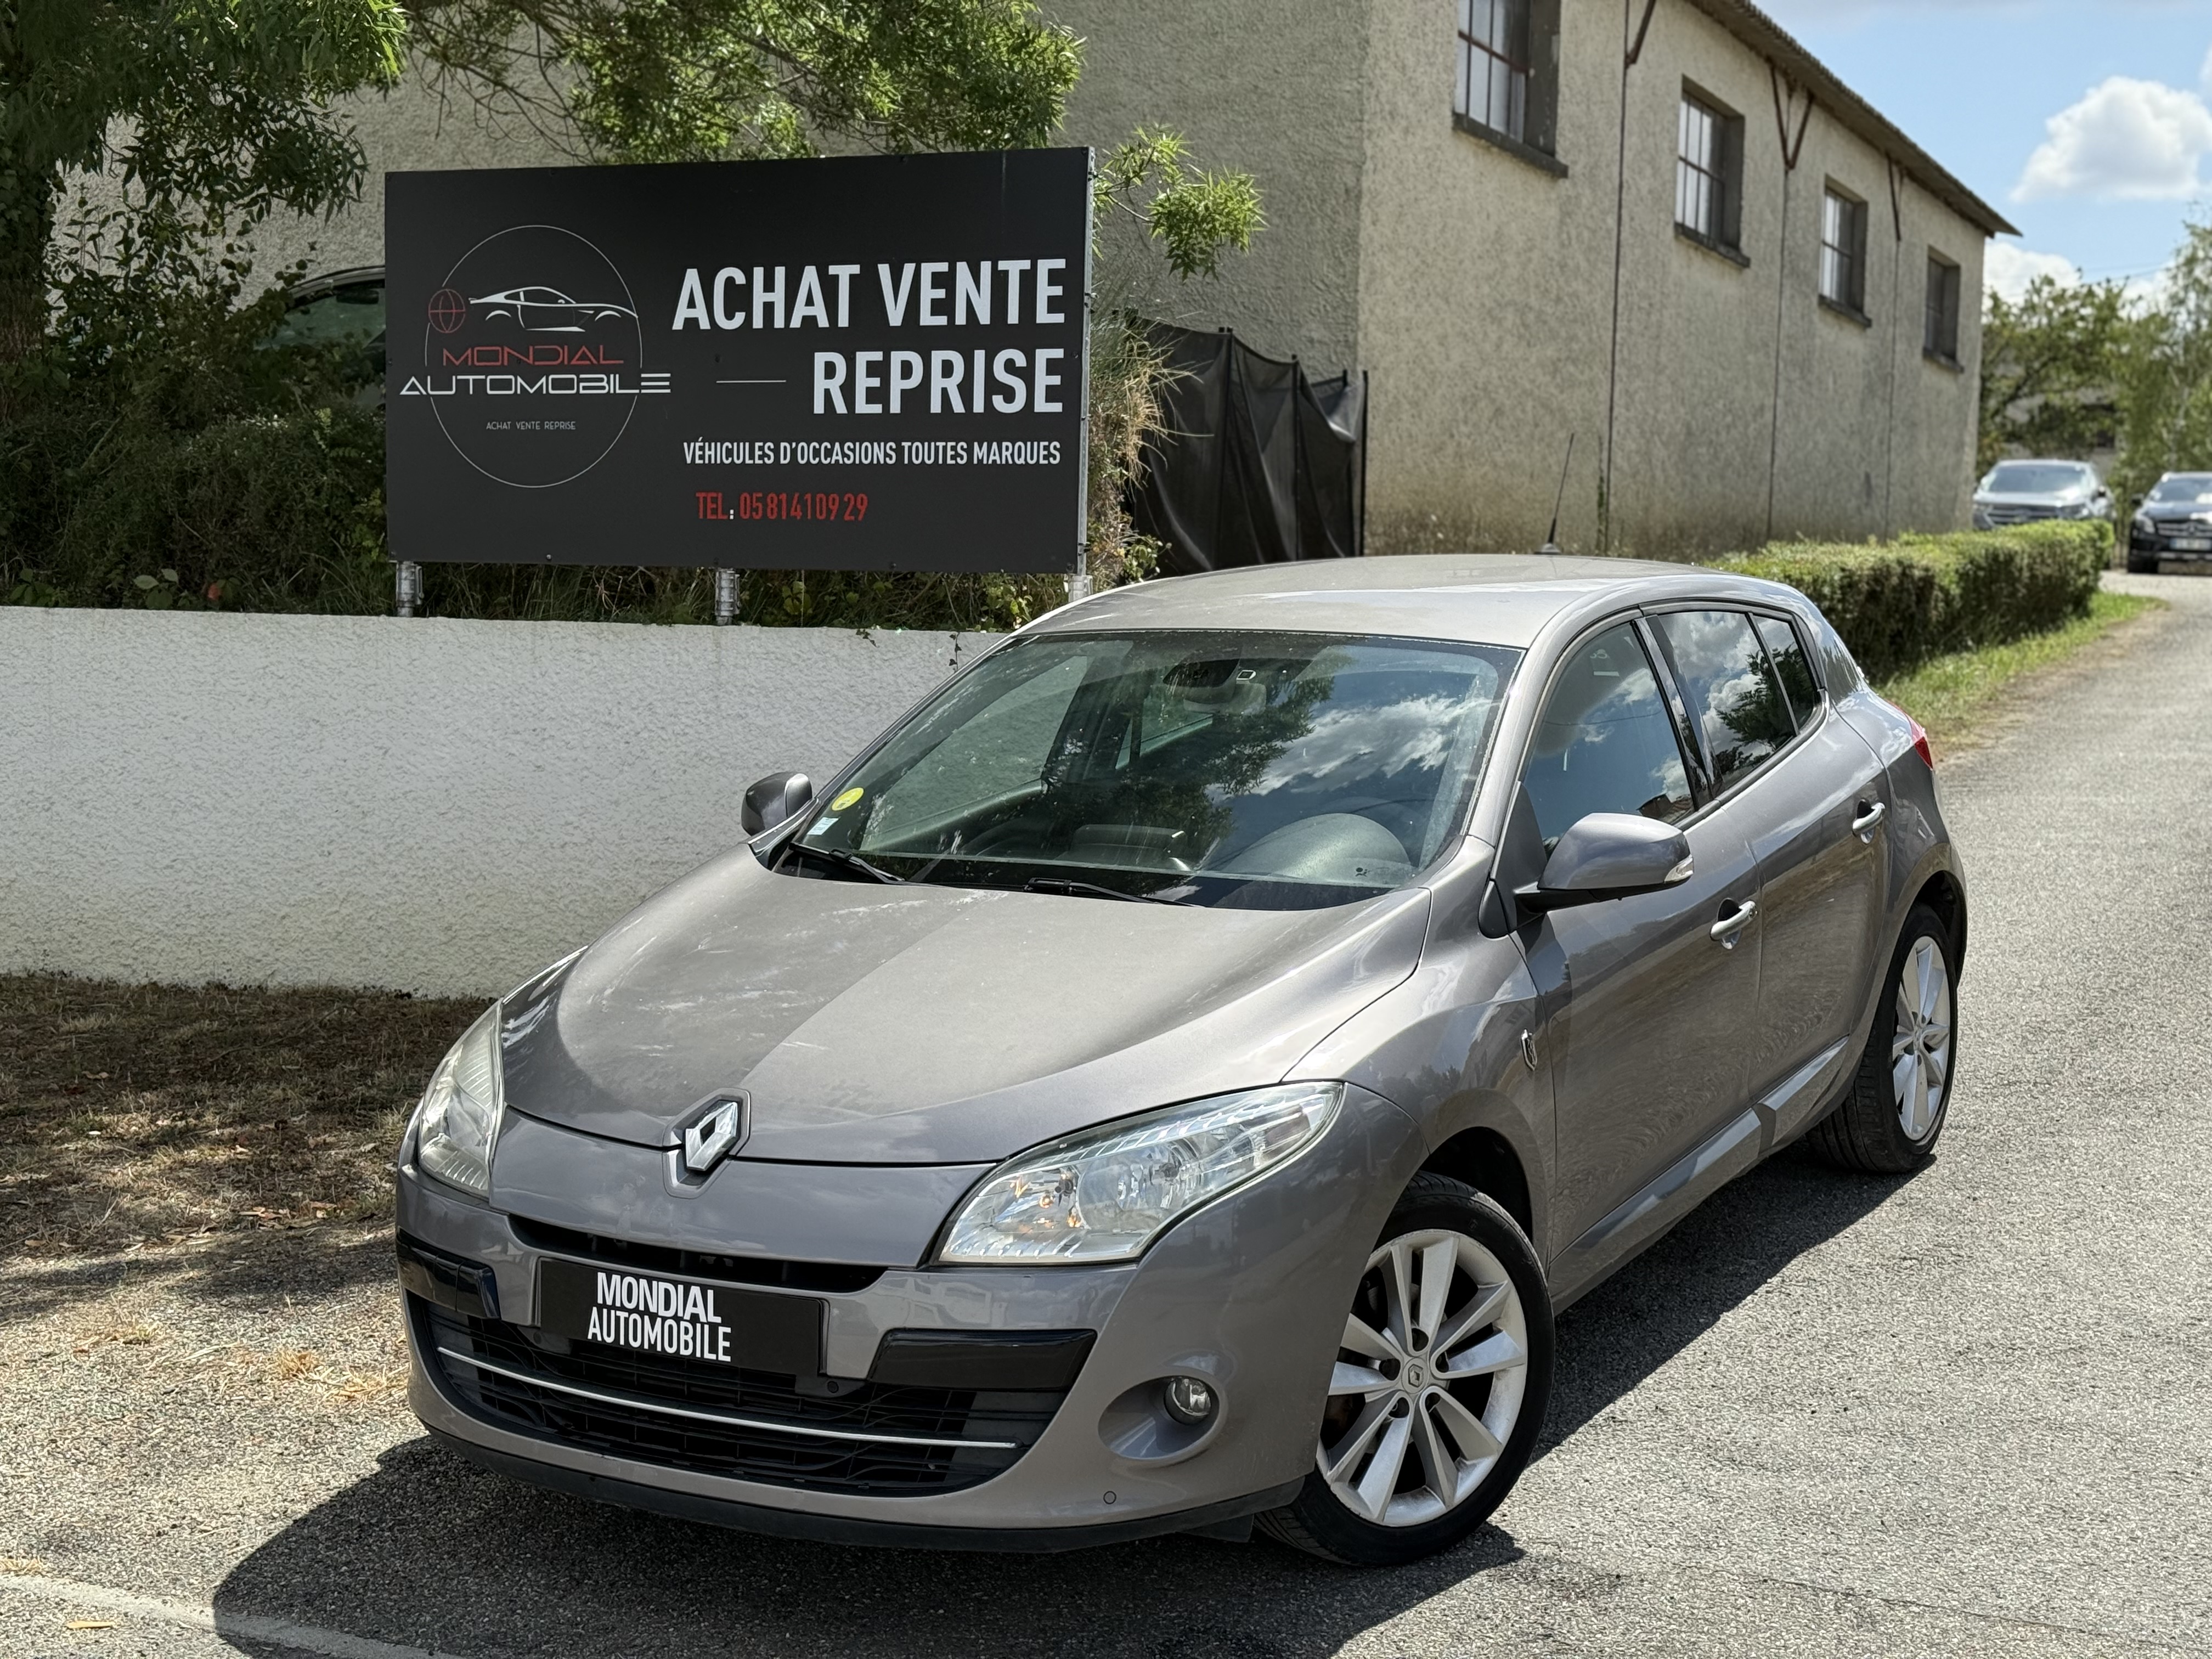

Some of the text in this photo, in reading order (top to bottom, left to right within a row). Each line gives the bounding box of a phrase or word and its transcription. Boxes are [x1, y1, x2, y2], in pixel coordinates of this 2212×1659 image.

[672, 258, 1066, 330] ACHAT VENTE
[442, 345, 624, 366] MONDIAL
[399, 373, 671, 395] AUTOMOBILE
[814, 348, 1064, 414] REPRISE
[486, 421, 576, 430] ACHAT VENTE REPRISE
[684, 437, 774, 464] VÉHICULES
[901, 442, 968, 465] TOUTES
[973, 441, 1061, 465] MARQUES
[696, 492, 734, 520] TEL:
[596, 1272, 722, 1324] MONDIAL
[587, 1306, 732, 1363] AUTOMOBILE
